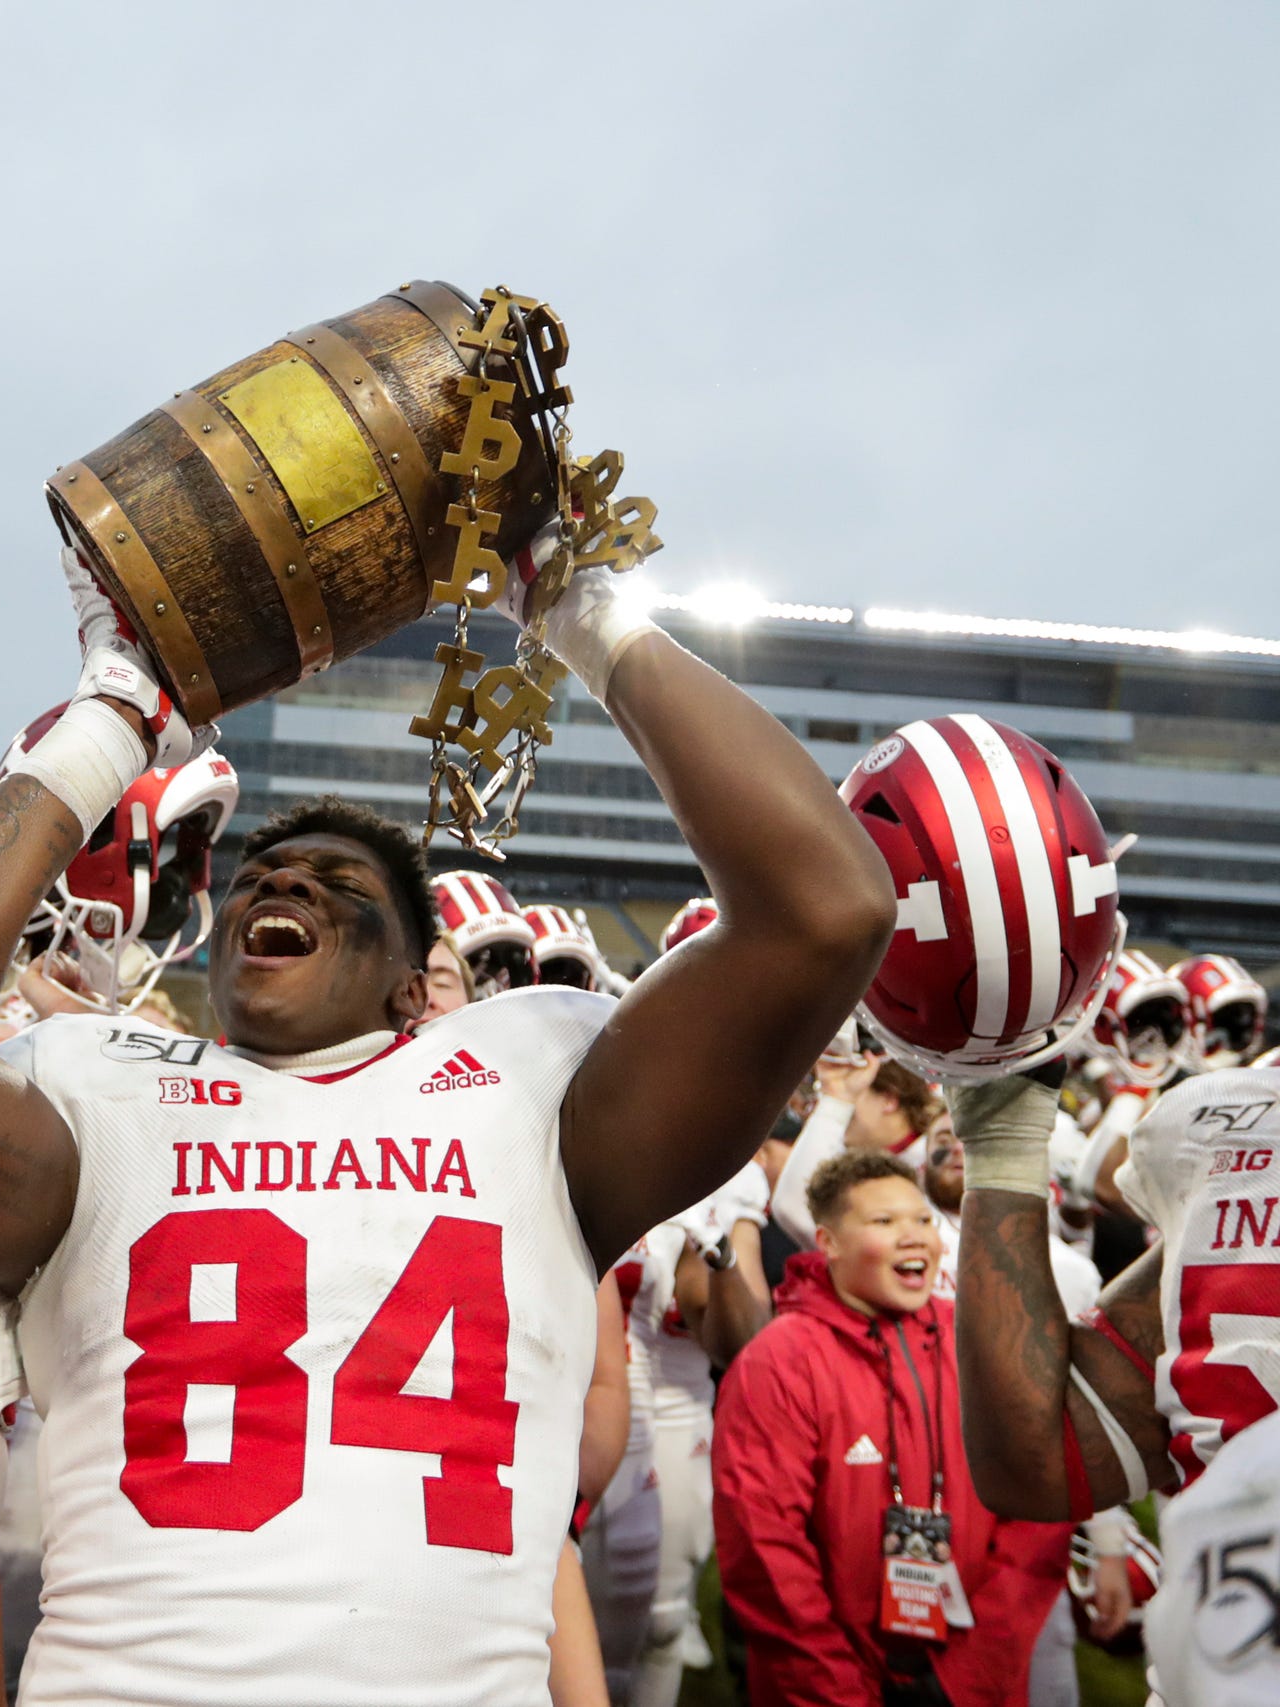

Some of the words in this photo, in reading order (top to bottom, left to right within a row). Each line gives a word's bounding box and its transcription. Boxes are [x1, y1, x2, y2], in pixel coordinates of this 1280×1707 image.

[98, 1028, 210, 1065] 150
[419, 1070, 501, 1094] adidas
[172, 1137, 477, 1198] INDIANA
[120, 1208, 520, 1556] 84
